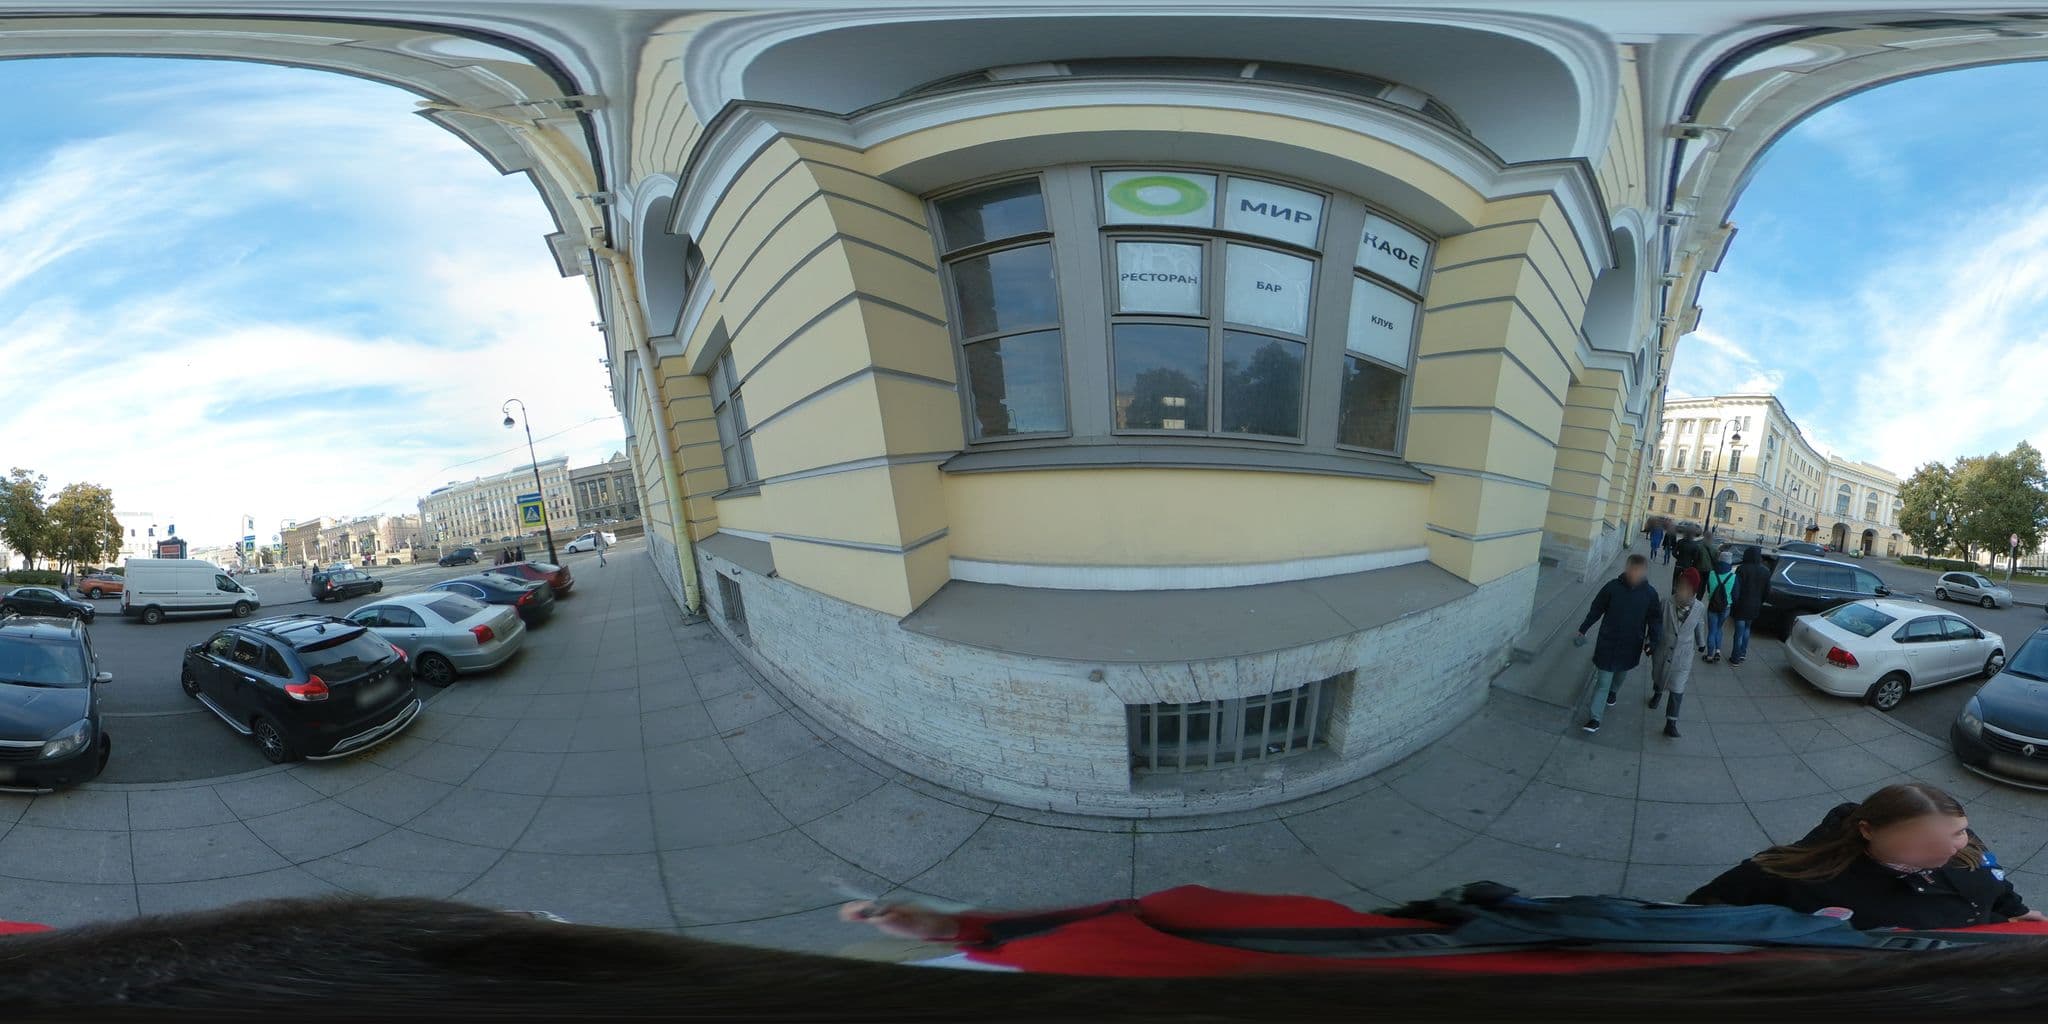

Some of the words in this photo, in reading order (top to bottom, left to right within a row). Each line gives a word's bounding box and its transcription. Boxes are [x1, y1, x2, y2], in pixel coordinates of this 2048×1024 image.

[1241, 199, 1312, 223] МИР
[1363, 231, 1420, 270] КАФЕ
[1121, 273, 1198, 285] РЕСТОРАН
[1256, 281, 1283, 293] БАР
[1371, 315, 1394, 330] КЛУБ
